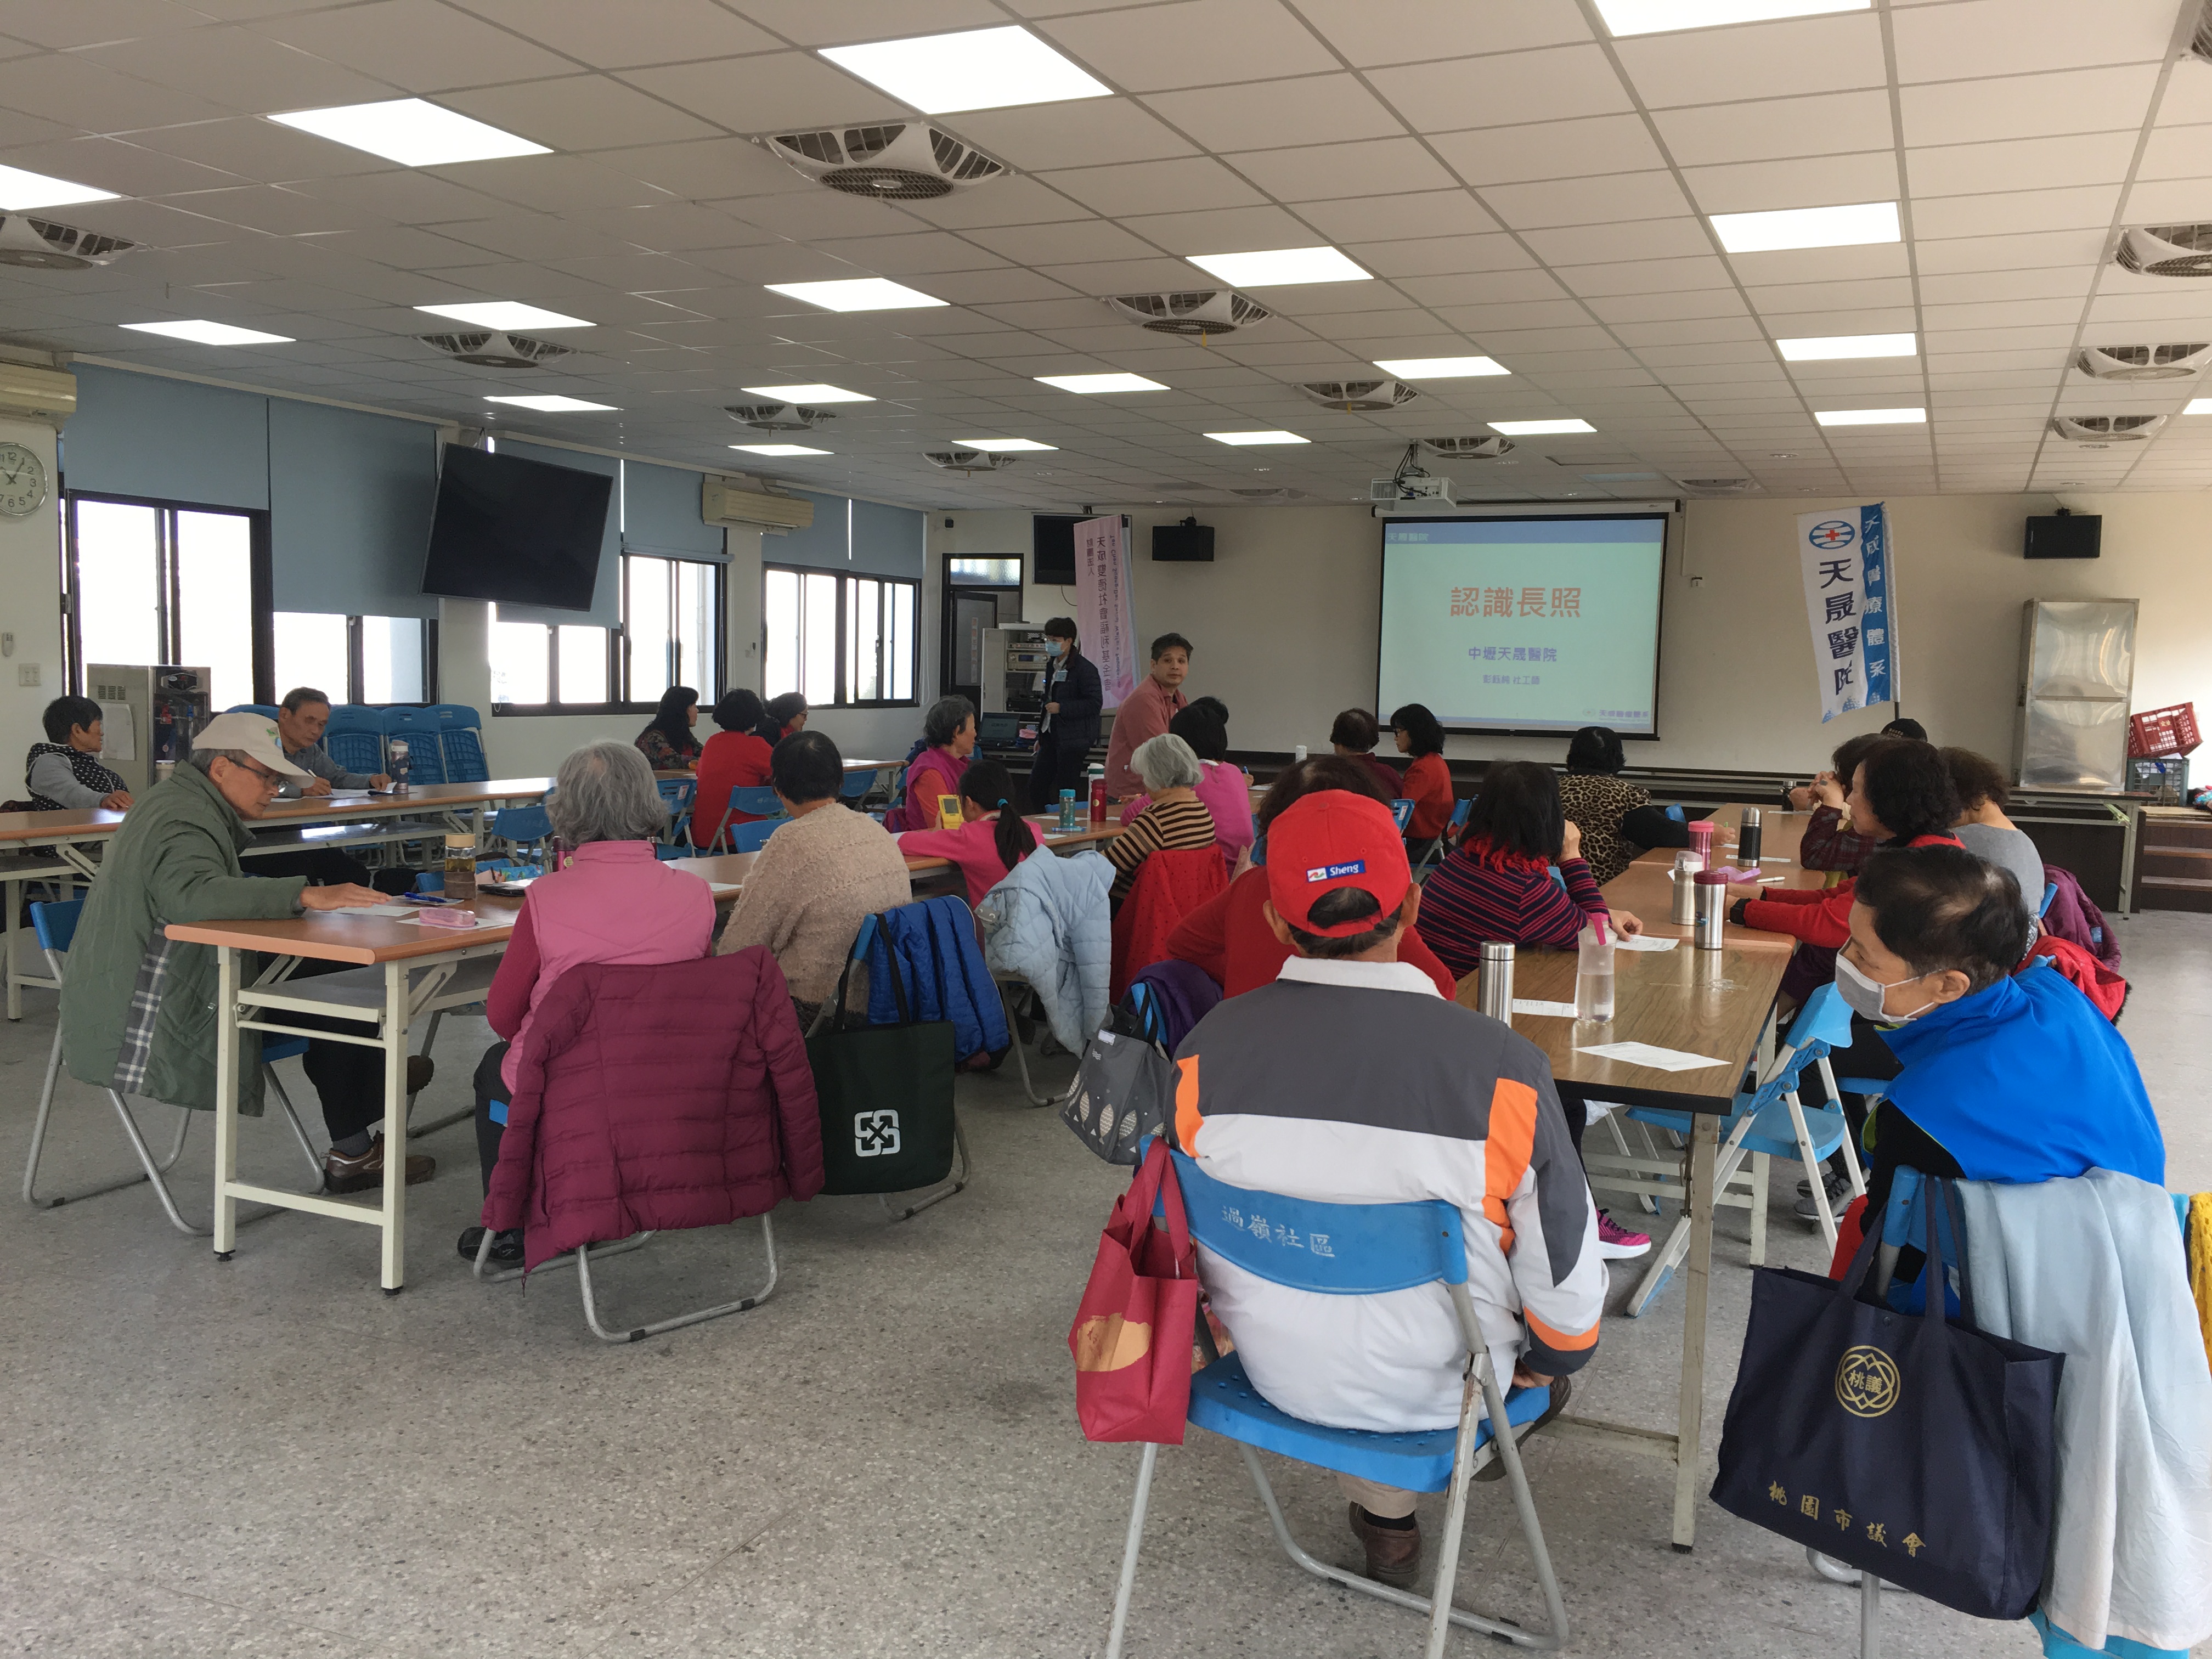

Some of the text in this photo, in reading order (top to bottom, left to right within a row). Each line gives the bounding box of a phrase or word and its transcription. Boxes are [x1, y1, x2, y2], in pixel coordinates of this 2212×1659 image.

[8, 452, 16, 461] 12
[27, 466, 34, 475] 2
[30, 478, 36, 487] 3
[26, 490, 33, 498] 4
[8, 498, 15, 507] 6
[19, 496, 25, 505] 5
[1451, 586, 1581, 618] 認識長照
[1819, 558, 1859, 696] 天晟醫院
[1468, 646, 1557, 662] 中壢天晟醫院
[1330, 864, 1359, 876] Sheng
[1221, 1206, 1335, 1257] 過嶺社區
[1848, 1370, 1883, 1394] 桃議
[1769, 1480, 1926, 1557] 桃園市議會
